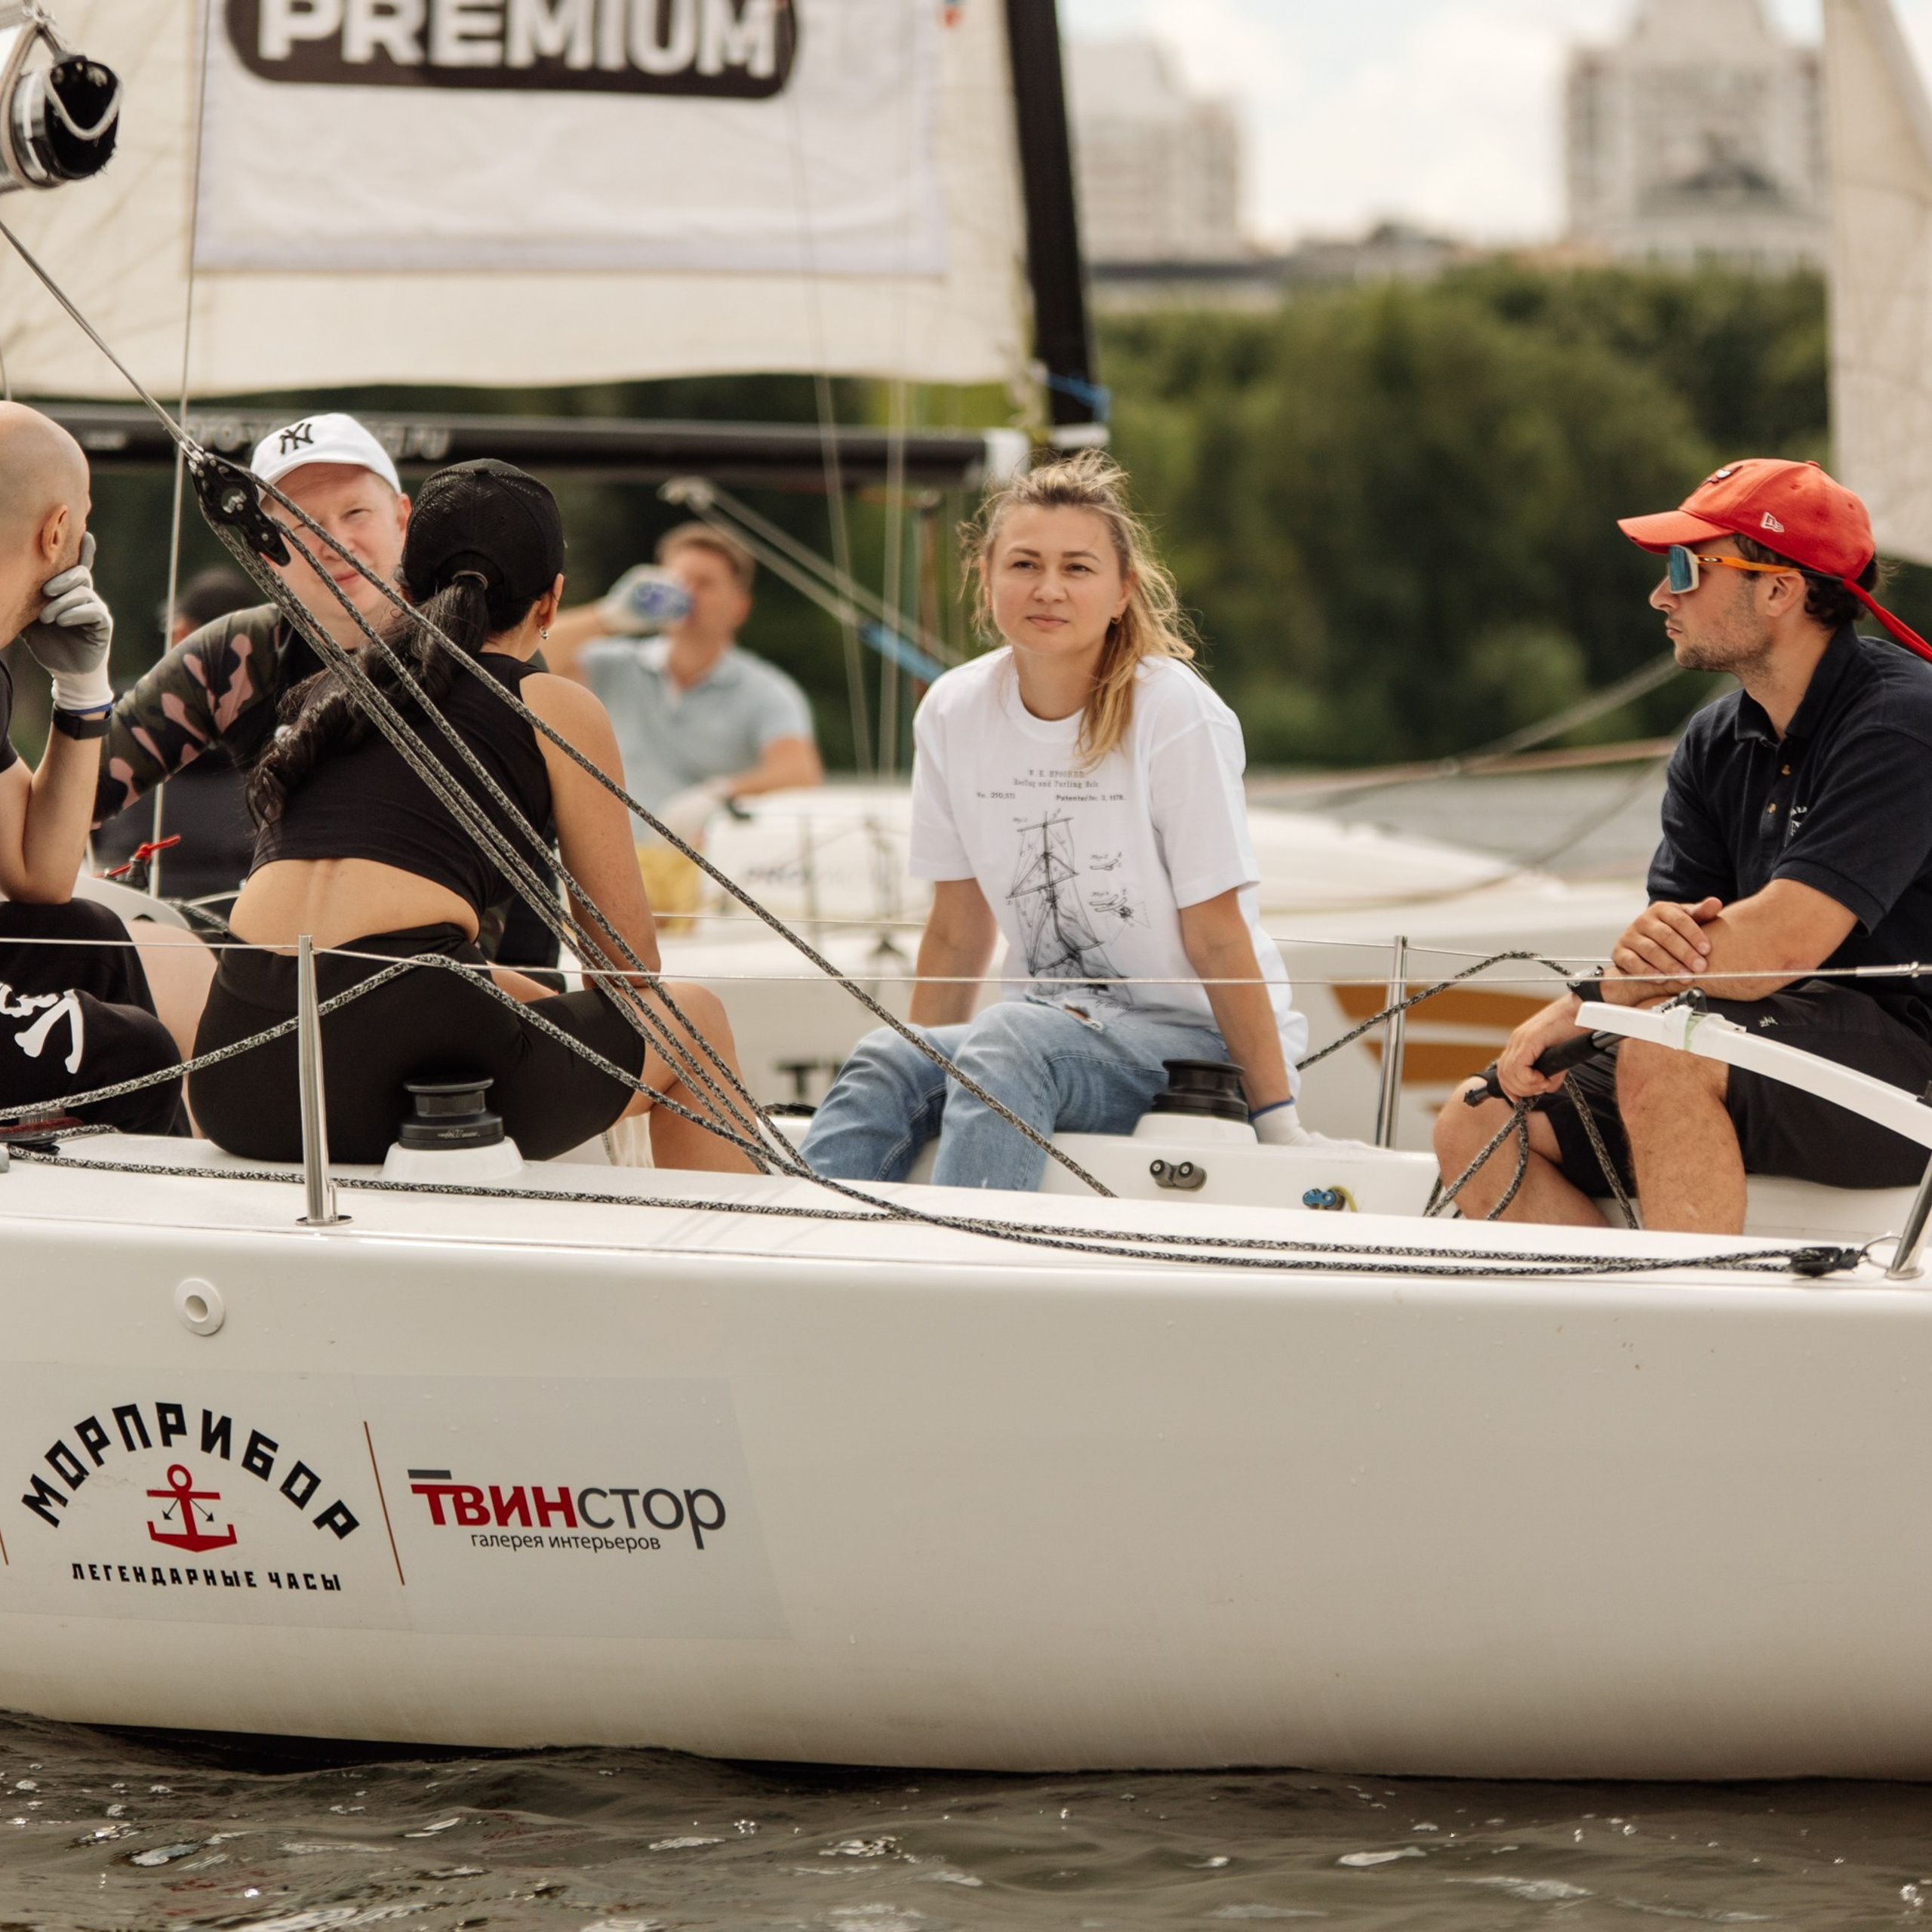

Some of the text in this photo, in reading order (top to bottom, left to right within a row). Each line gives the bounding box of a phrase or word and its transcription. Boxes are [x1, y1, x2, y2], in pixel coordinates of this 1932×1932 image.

[257, 0, 776, 76] PREMIUM
[21, 1401, 360, 1540] МОРПРИБОР
[471, 1532, 661, 1554] галерея интерьеров
[72, 1562, 341, 1591] ЛЕГЕНДАРНЫЕ ЧАСЫ
